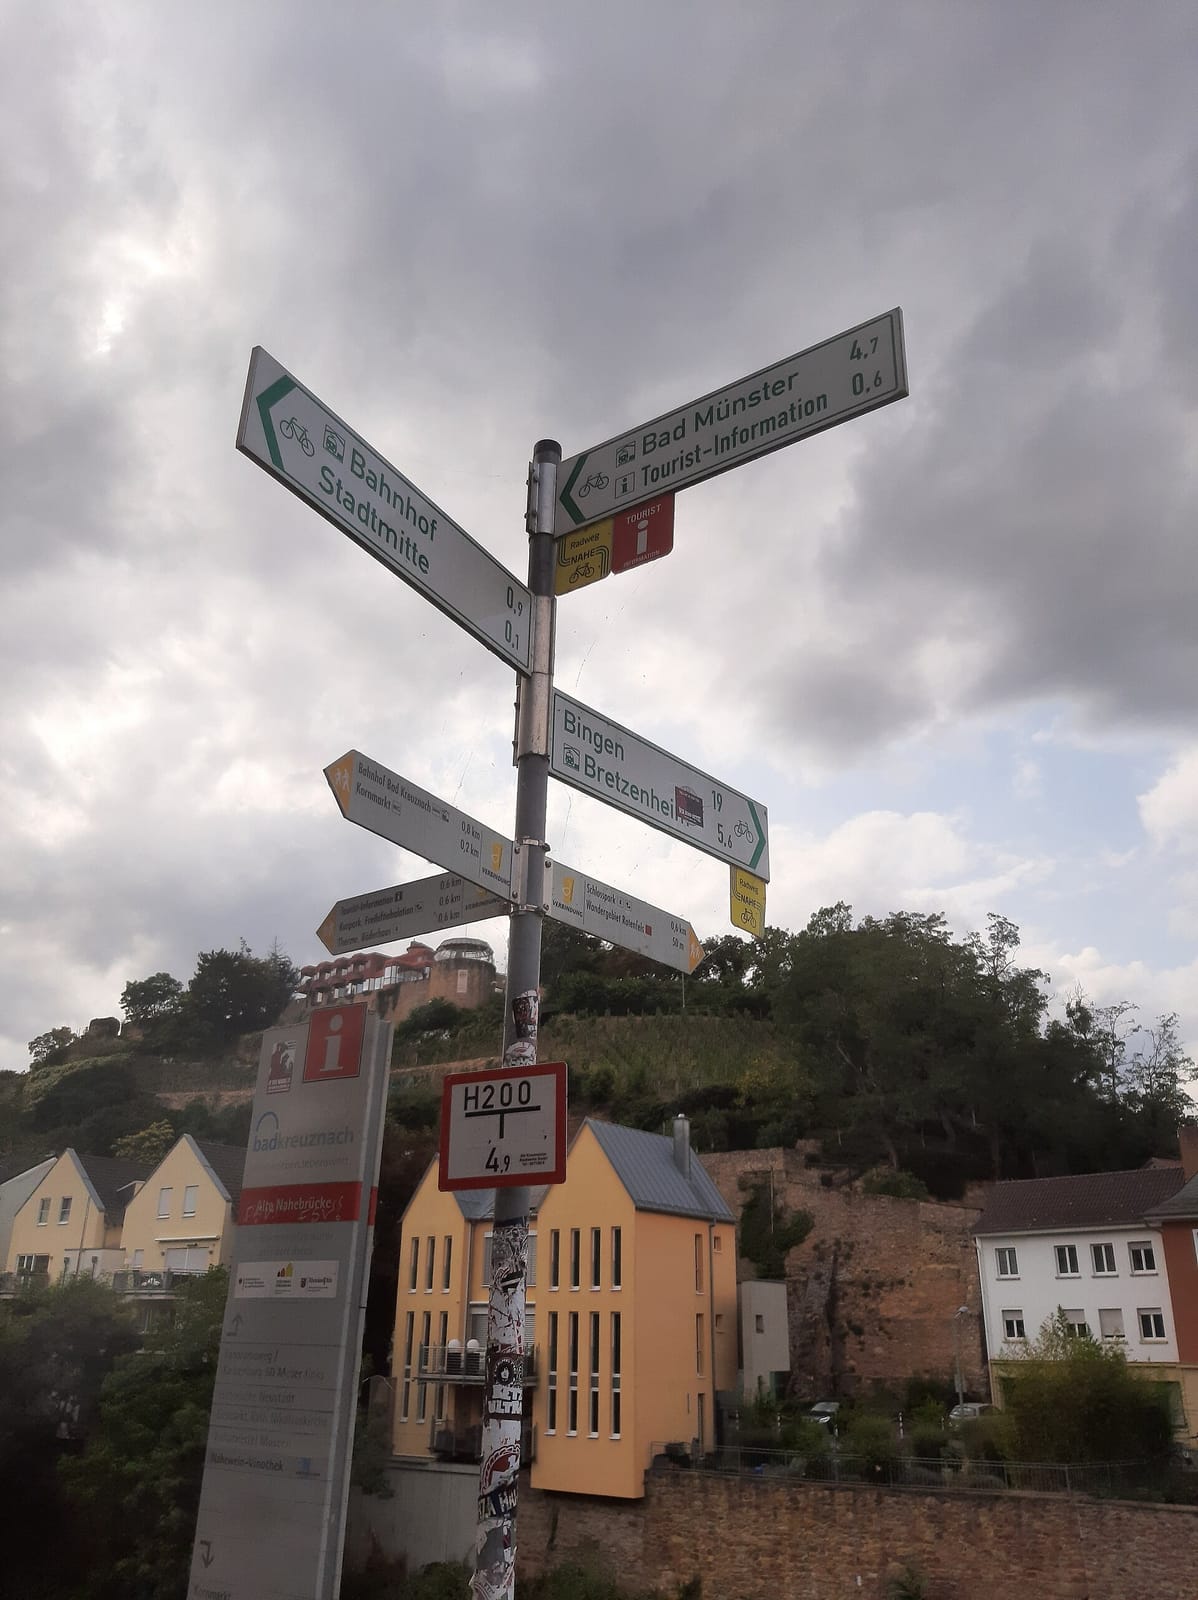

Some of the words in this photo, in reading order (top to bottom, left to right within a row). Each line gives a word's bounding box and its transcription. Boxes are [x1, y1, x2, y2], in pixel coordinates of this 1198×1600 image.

[642, 418, 686, 456] Bad
[695, 371, 800, 433] Münster
[641, 393, 828, 487] Tourist-Information
[350, 447, 438, 541] Bahnhof
[317, 465, 430, 575] Stadtmitte
[626, 503, 663, 525] TOURIST
[570, 532, 600, 550] Radweg
[570, 548, 596, 565] NAHE
[564, 709, 625, 762] Bingen
[356, 783, 391, 810] Kornmarkt
[358, 762, 386, 788] Bahnhof
[387, 778, 399, 794] Bad
[400, 787, 432, 813] Kreuznach
[584, 753, 690, 826] Bretzenhei
[711, 789, 723, 813] 19
[472, 826, 481, 841] km
[470, 844, 480, 858] km
[586, 884, 616, 905] Schlosspark
[586, 899, 621, 923] Wandergebiet
[622, 916, 645, 934] Rotenfels
[679, 925, 687, 936] km
[463, 1080, 531, 1111] H200
[257, 1198, 274, 1213] Alte
[276, 1195, 332, 1211] Nahebrücke
